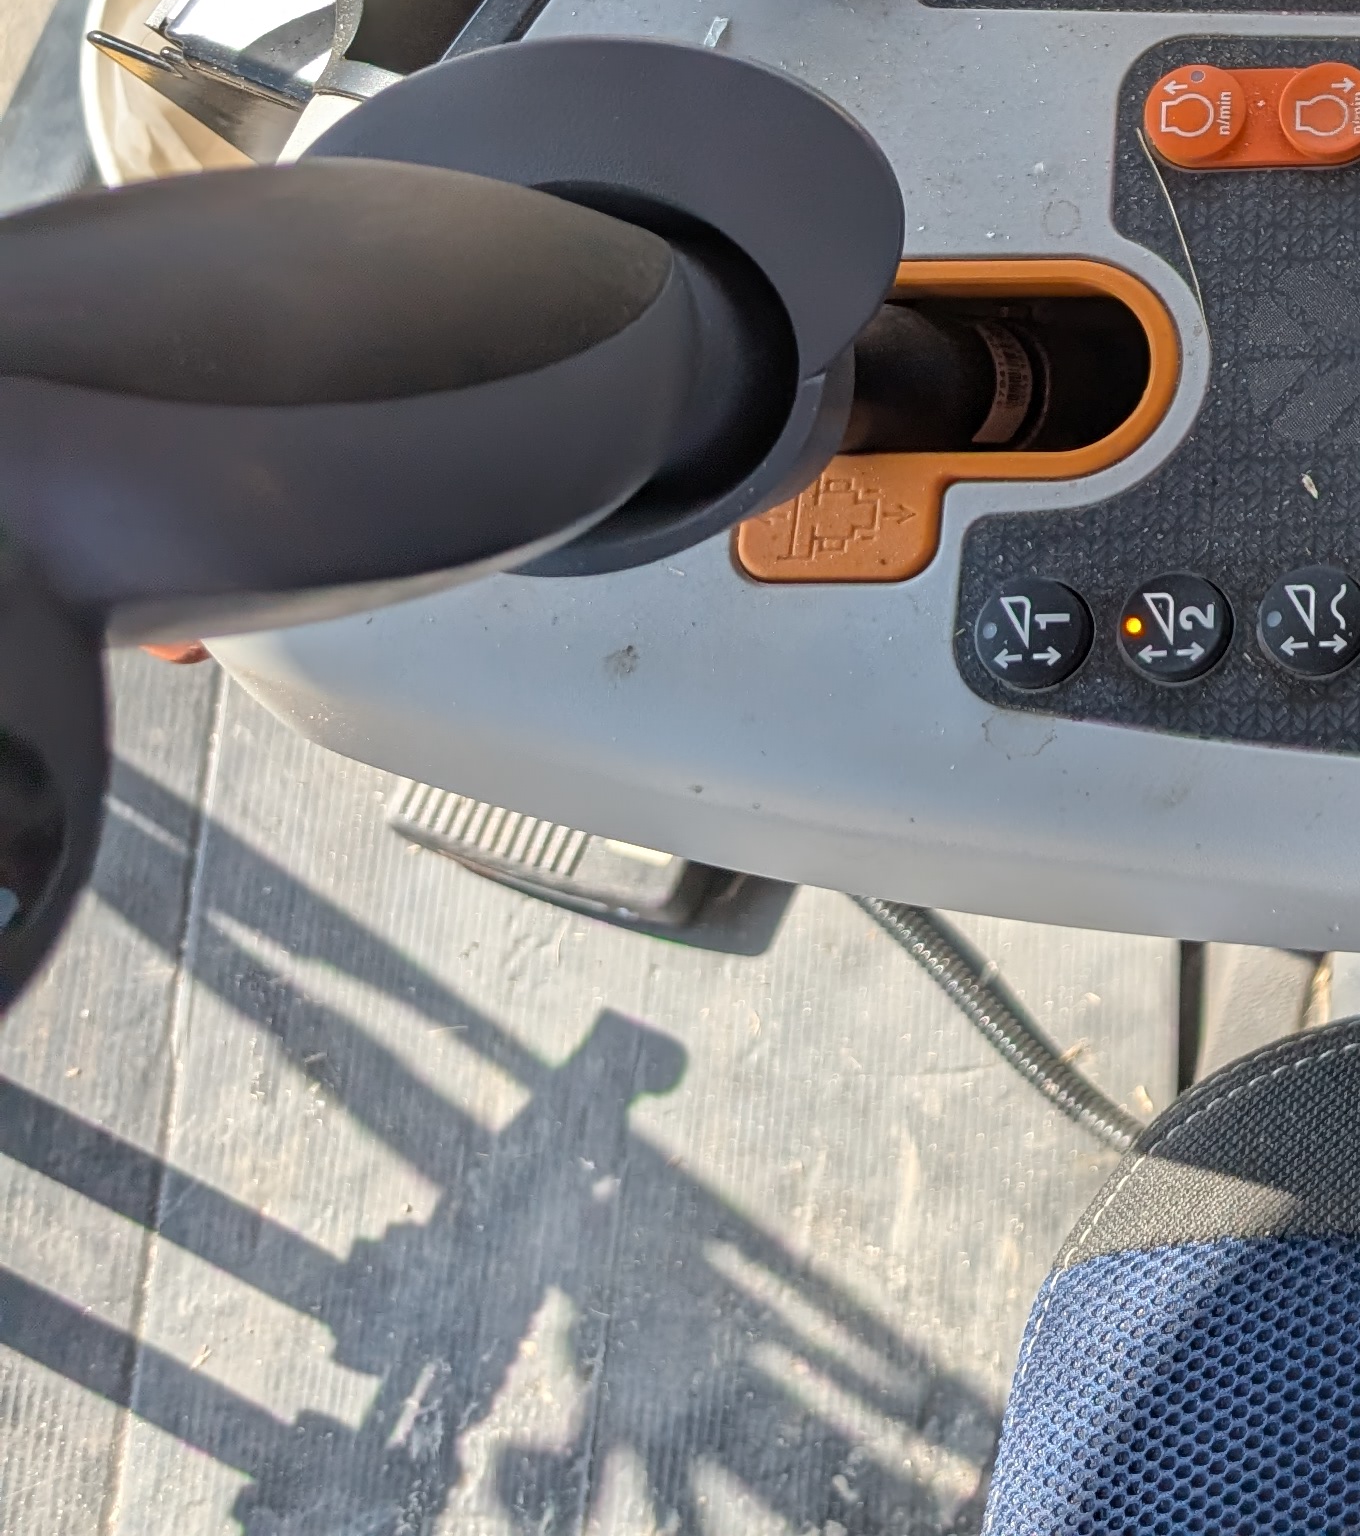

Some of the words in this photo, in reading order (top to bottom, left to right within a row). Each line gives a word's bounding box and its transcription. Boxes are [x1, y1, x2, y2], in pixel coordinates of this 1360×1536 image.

[1216, 91, 1232, 136] n/min
[1034, 613, 1070, 630] 1
[1179, 603, 1215, 631] 2
